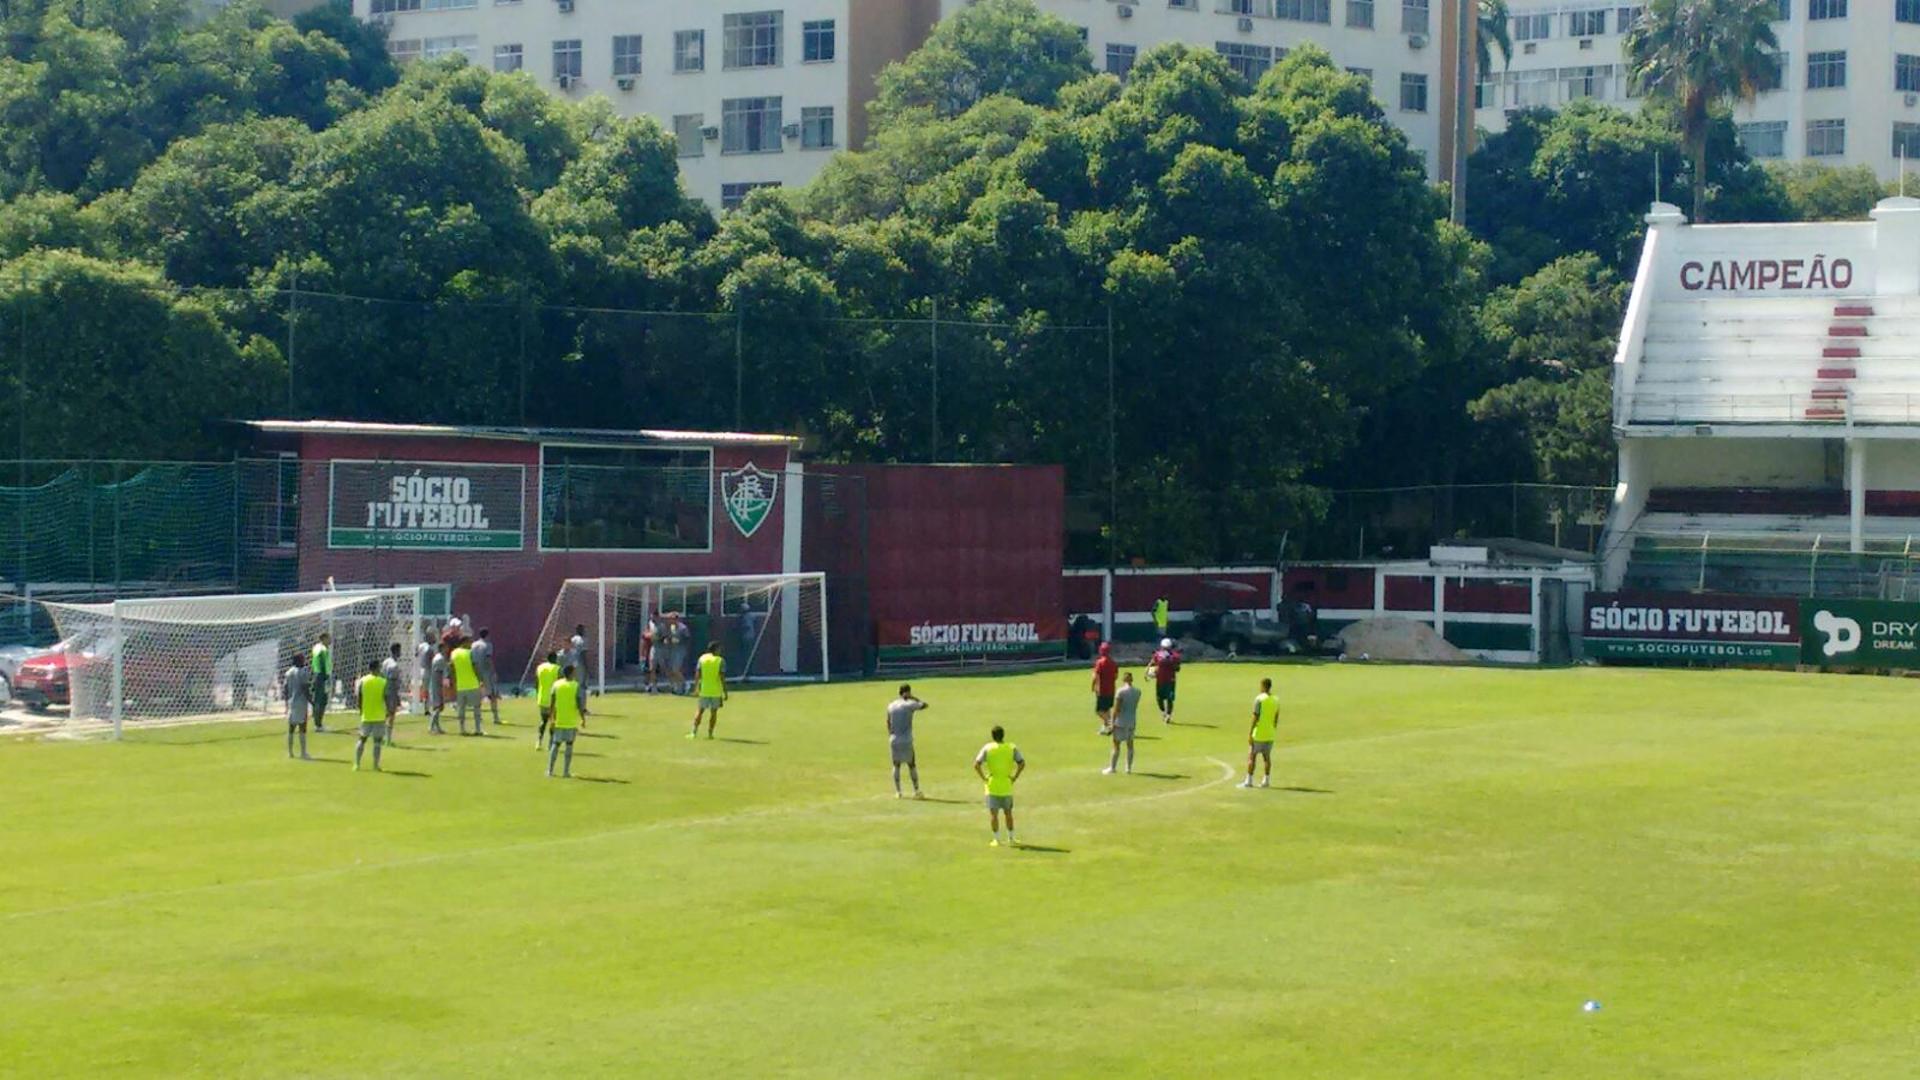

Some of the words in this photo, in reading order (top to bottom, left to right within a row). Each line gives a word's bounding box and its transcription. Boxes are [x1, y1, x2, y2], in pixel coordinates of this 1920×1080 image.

[1680, 254, 1853, 291] CAMPEÃO
[391, 468, 471, 504] SÓCIO
[366, 502, 490, 529] FUTEBOL
[910, 620, 960, 645] SÓCIO
[961, 623, 1039, 643] FUTEBOL
[1590, 601, 1663, 632] SÓCIO
[1668, 608, 1791, 635] FUTEBOL
[1872, 621, 1919, 637] DRY
